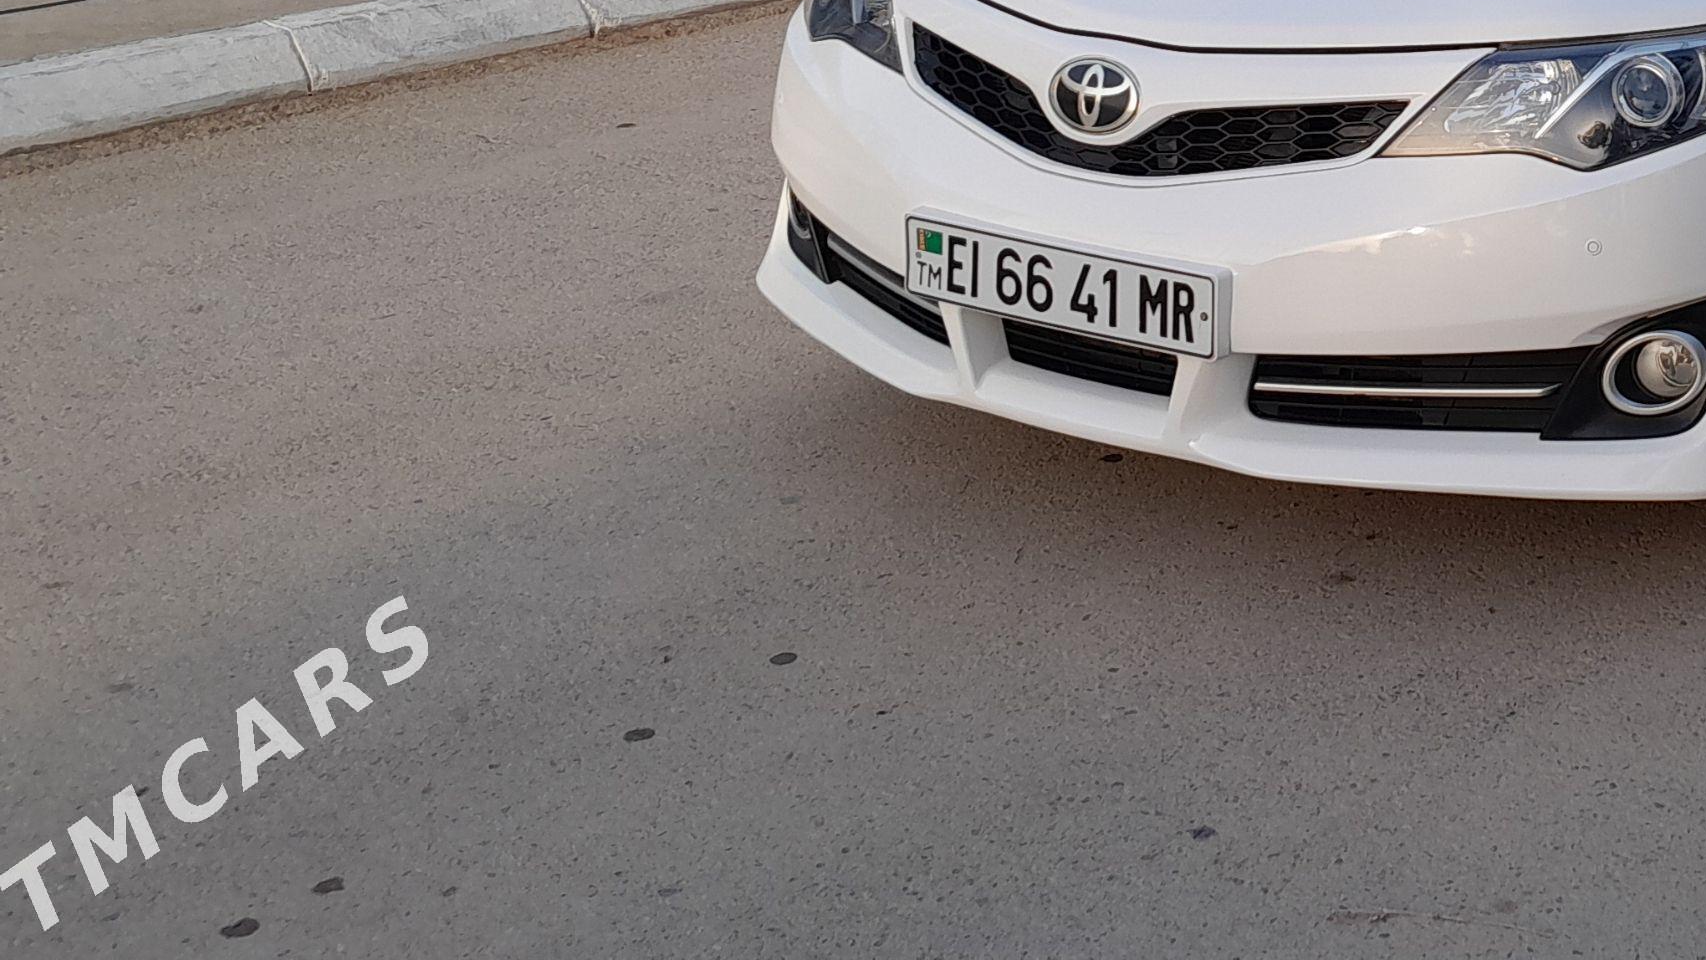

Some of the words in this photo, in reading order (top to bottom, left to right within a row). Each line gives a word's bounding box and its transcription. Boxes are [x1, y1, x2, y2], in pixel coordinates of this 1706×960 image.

[917, 261, 942, 290] TM
[947, 235, 979, 297] EI
[996, 248, 1053, 312] 66
[1070, 264, 1117, 327] 41
[1139, 274, 1194, 343] MR
